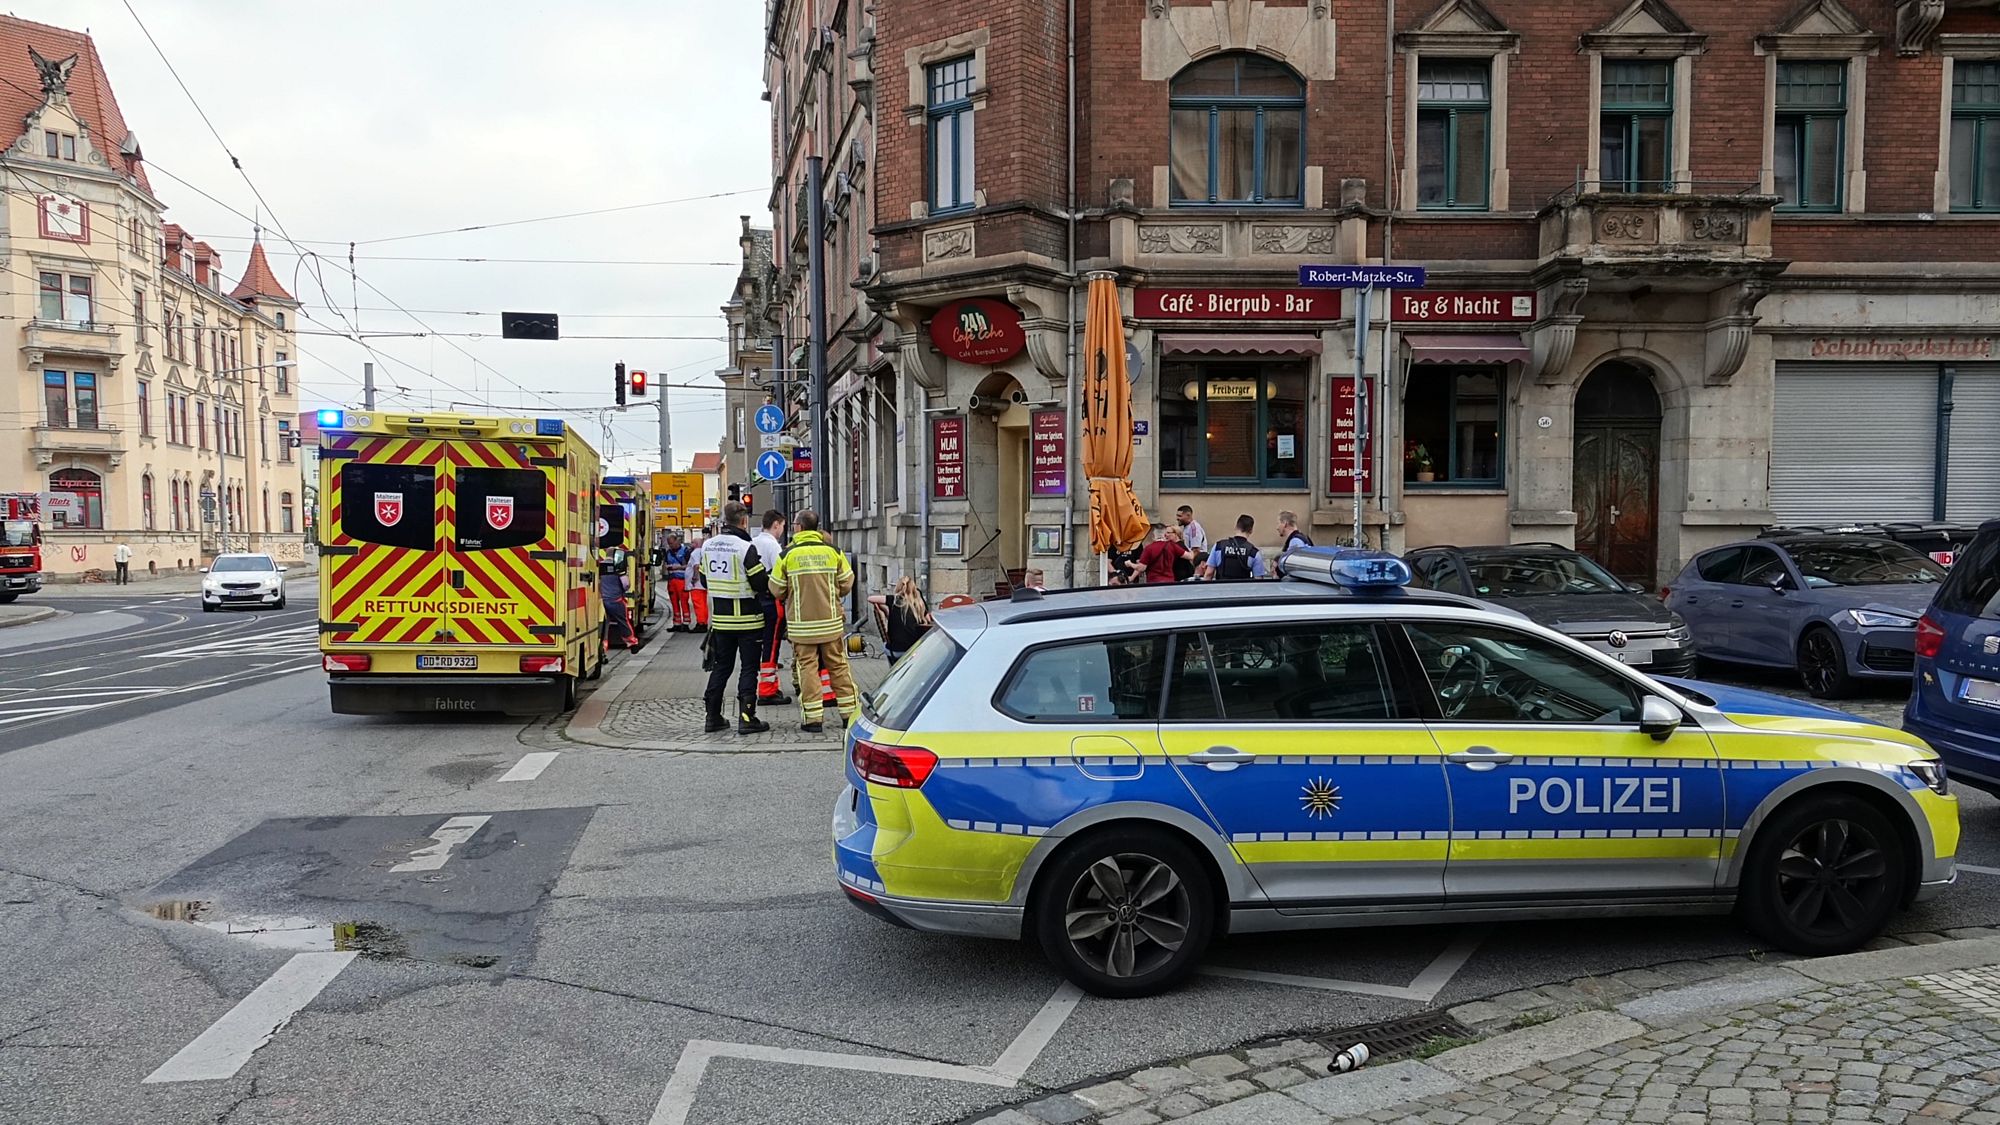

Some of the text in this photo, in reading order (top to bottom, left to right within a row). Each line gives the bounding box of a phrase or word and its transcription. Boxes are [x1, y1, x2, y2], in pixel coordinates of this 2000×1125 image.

[1308, 270, 1415, 284] Robert-Matzke-Str.
[1159, 293, 1314, 316] Café Bierpub Bar
[1402, 296, 1501, 318] Tag & Nacht
[961, 312, 987, 332] 24h
[952, 326, 975, 349] Café
[1212, 384, 1250, 395] Freiberger
[940, 437, 958, 451] WLAN
[709, 560, 728, 573] C-2
[365, 600, 519, 615] RETTUNGSDIENST
[423, 657, 475, 667] DD RD 9321
[435, 698, 476, 710] fahrtec
[1509, 777, 1681, 814] POLIZEI
